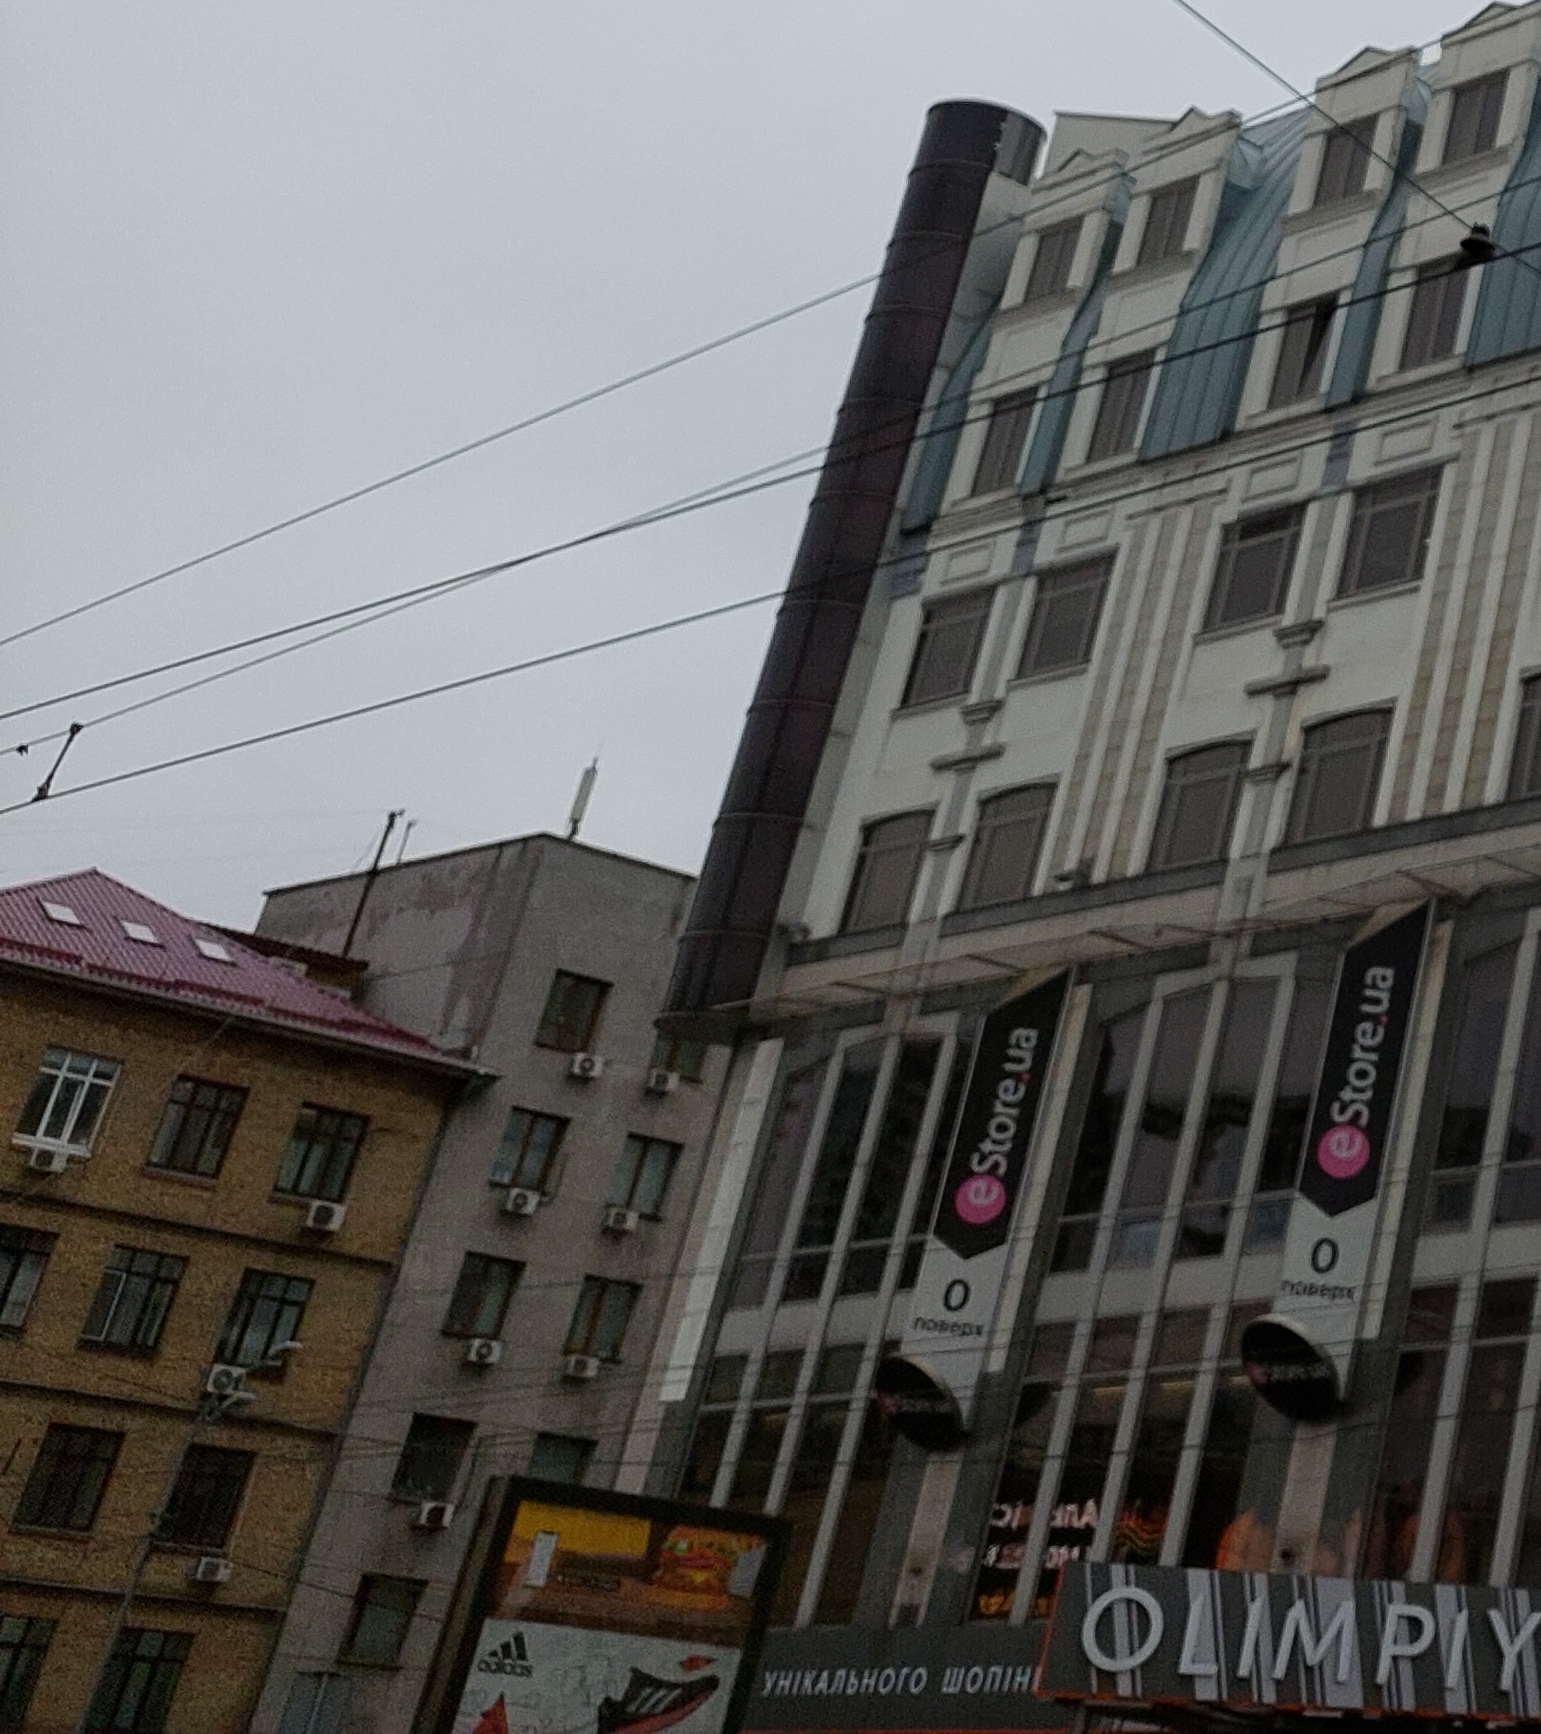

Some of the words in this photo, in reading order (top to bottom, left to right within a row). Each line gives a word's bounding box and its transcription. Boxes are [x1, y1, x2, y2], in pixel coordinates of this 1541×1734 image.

[968, 1026, 1039, 1207] eStore.ua
[1329, 965, 1395, 1160] eStore.ua
[760, 1665, 929, 1697] УНІКАЛЬНОГО
